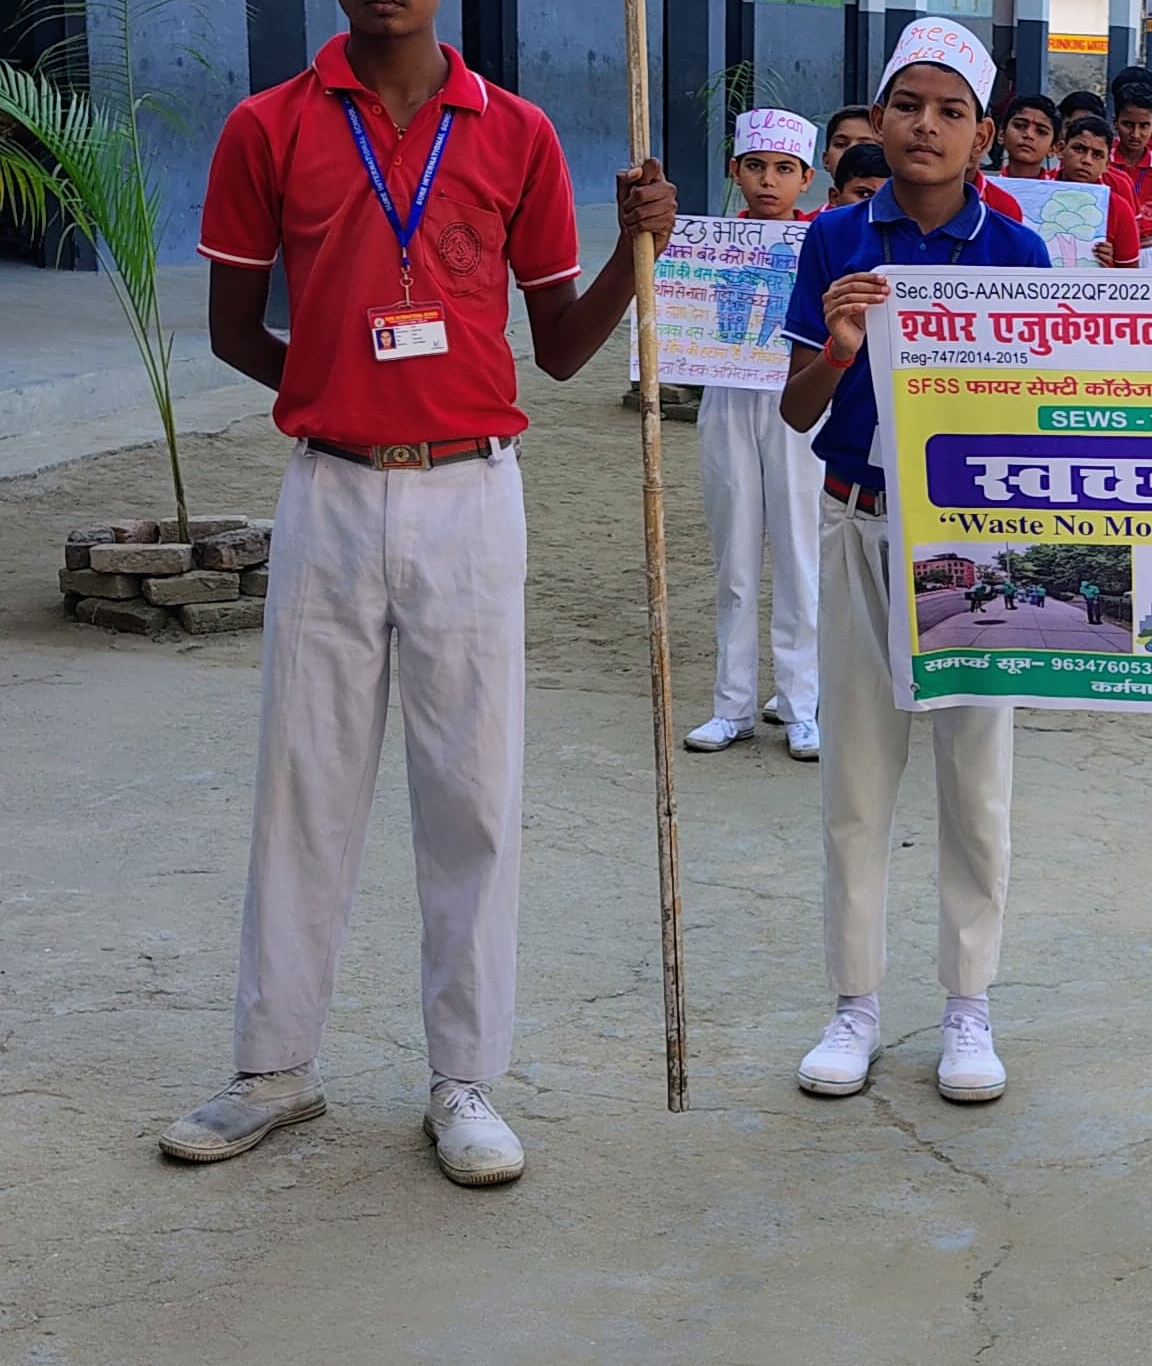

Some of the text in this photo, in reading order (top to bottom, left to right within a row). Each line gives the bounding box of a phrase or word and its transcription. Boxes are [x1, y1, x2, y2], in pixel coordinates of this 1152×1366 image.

[749, 107, 804, 135] Clean
[746, 131, 802, 154] India
[898, 302, 977, 342] श्योर
[900, 351, 1029, 366] Reg-747/2014-2015
[907, 378, 960, 395] SFSS
[966, 379, 1021, 396] फायर
[1051, 410, 1128, 428] SEWS
[1053, 515, 1094, 536] No
